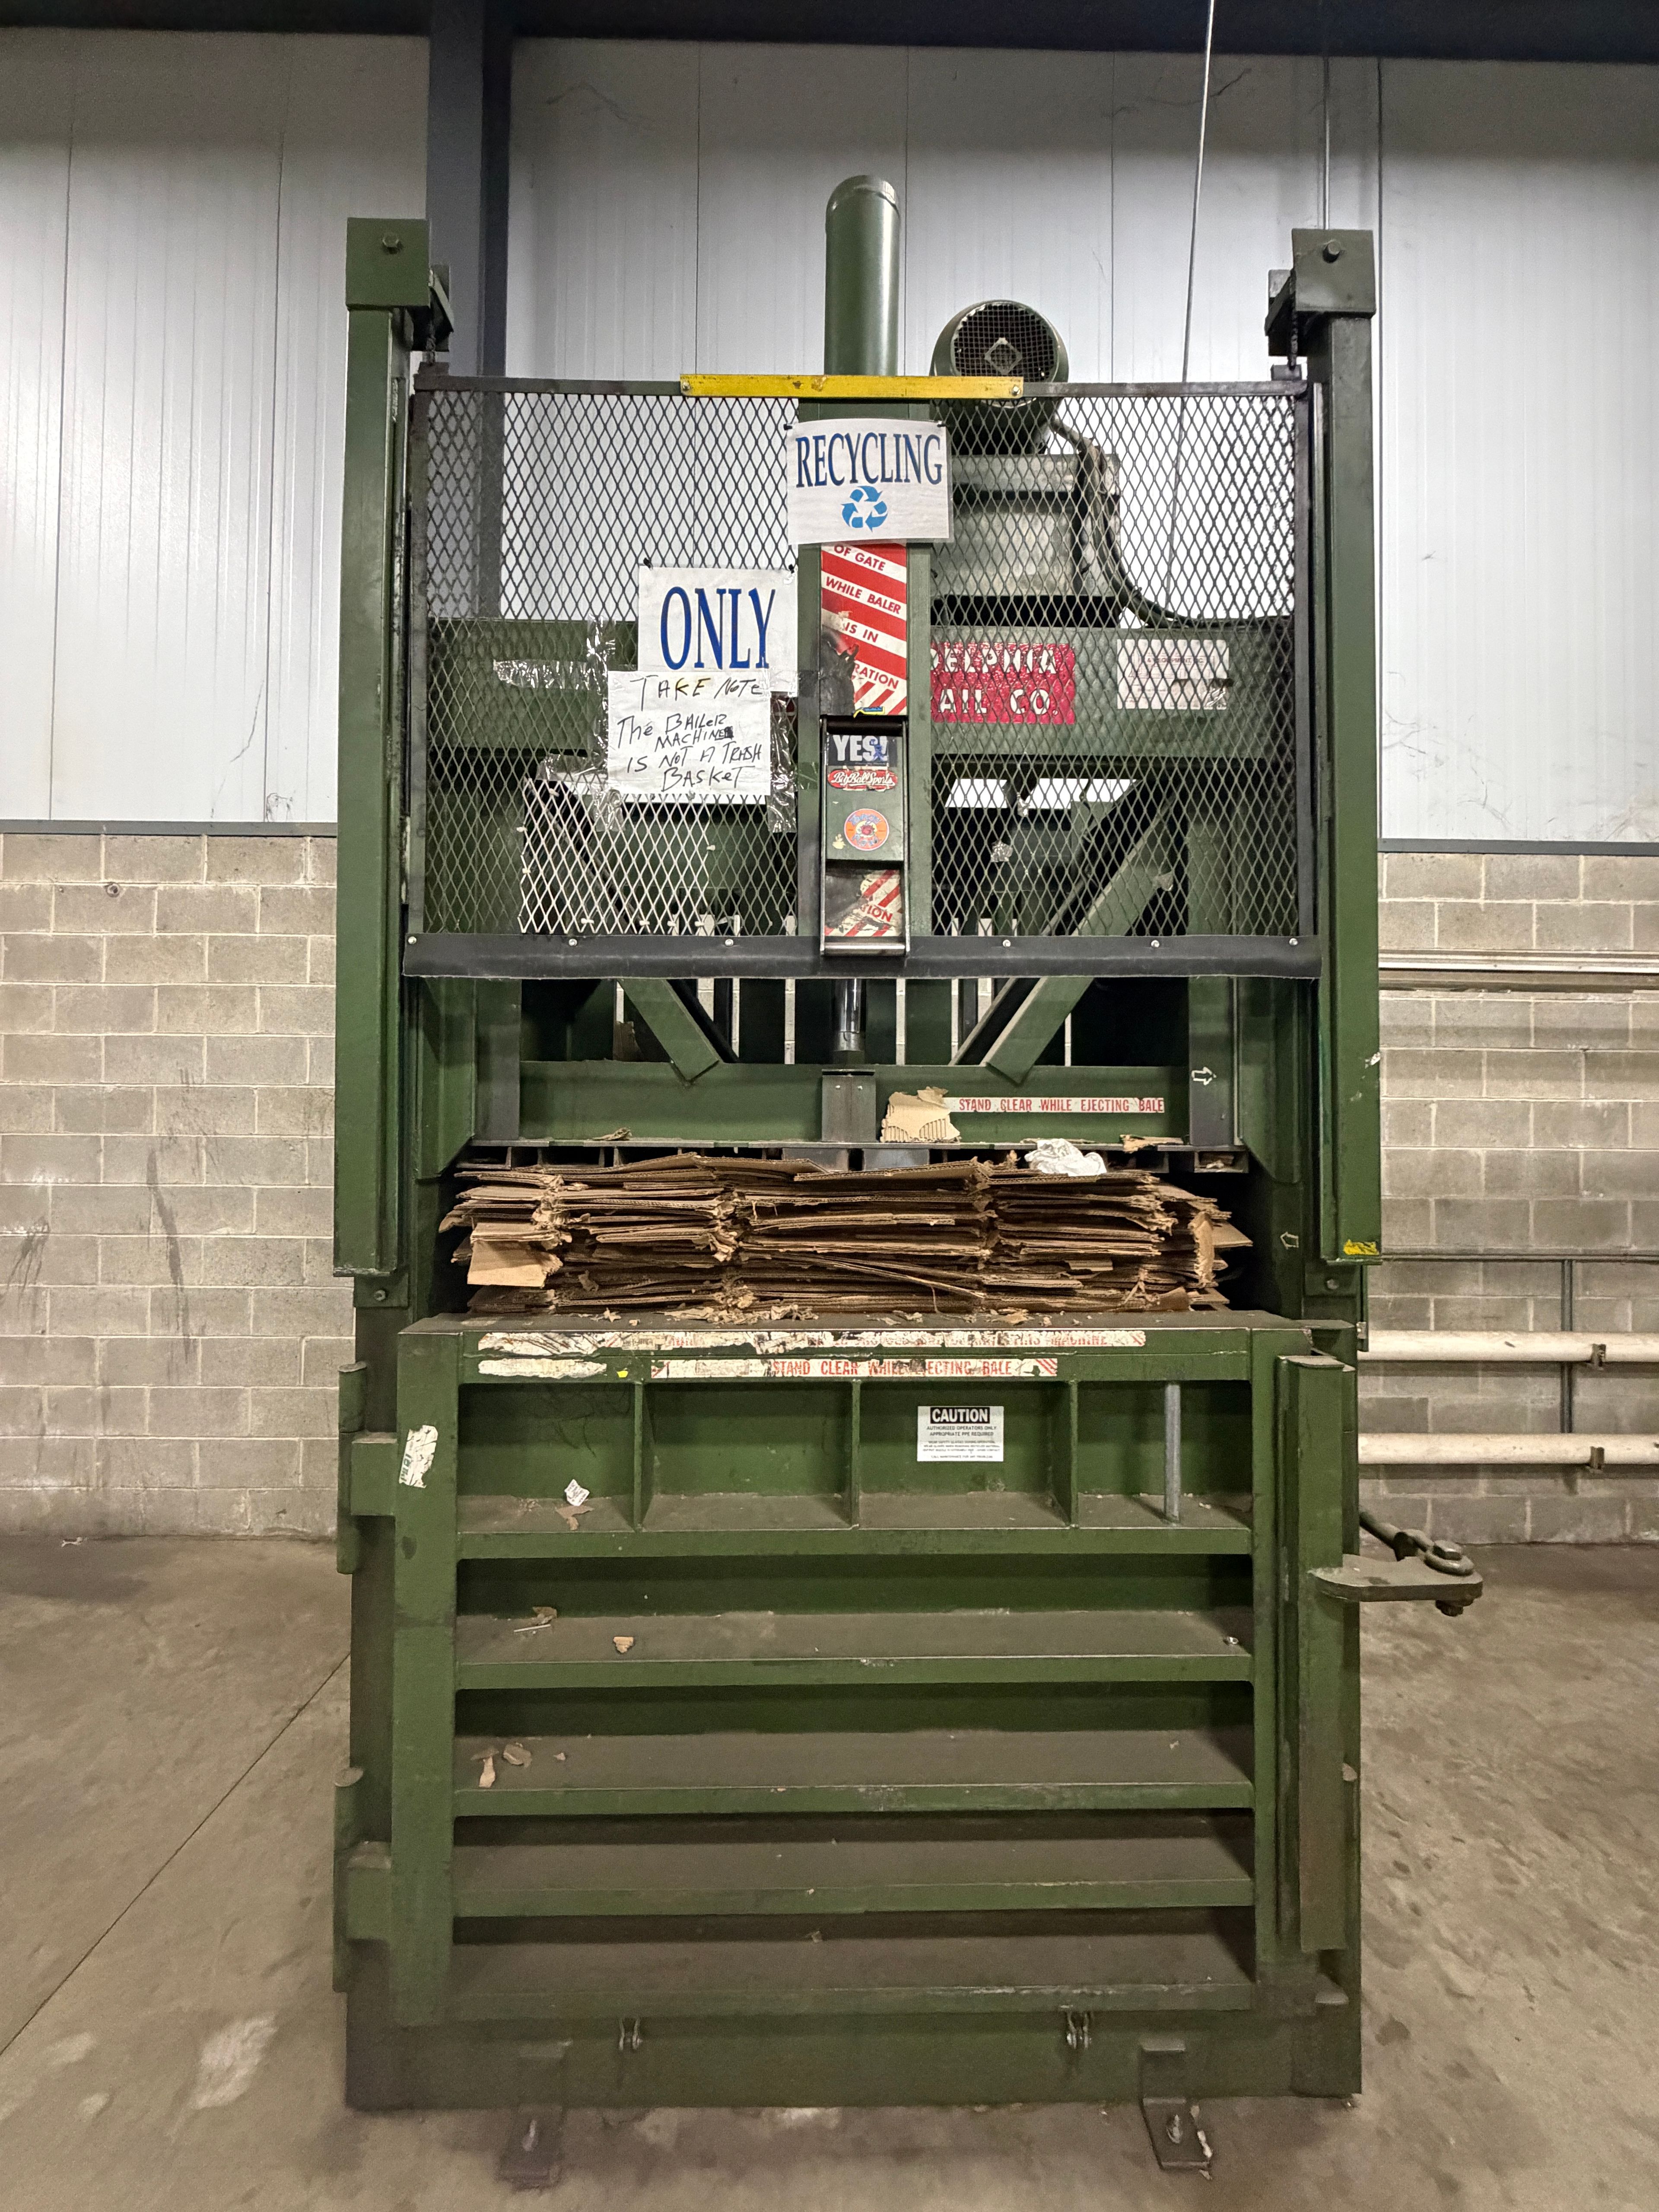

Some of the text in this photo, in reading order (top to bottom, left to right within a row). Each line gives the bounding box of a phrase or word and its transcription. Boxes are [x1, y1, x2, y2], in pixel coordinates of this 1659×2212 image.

[795, 432, 942, 488] RECYCLING
[834, 544, 886, 571] OF GATE
[826, 576, 901, 614] WHILE BALER
[660, 586, 776, 670] ONLY
[845, 622, 879, 643] IS IN
[630, 674, 711, 712] TAKE
[939, 689, 1058, 715] AIL CO.
[617, 715, 653, 749] The
[626, 756, 648, 773] IS
[700, 746, 716, 763] A
[722, 741, 762, 764] TRASH
[959, 1099, 1163, 1112] STAND CLEAR WHILE EJECTING BALE
[772, 1360, 810, 1375] STAND
[821, 1360, 859, 1375] CLEAR
[915, 1361, 971, 1375] ECTING
[982, 1361, 1012, 1375] BALE
[932, 1408, 988, 1422] CAUTION
